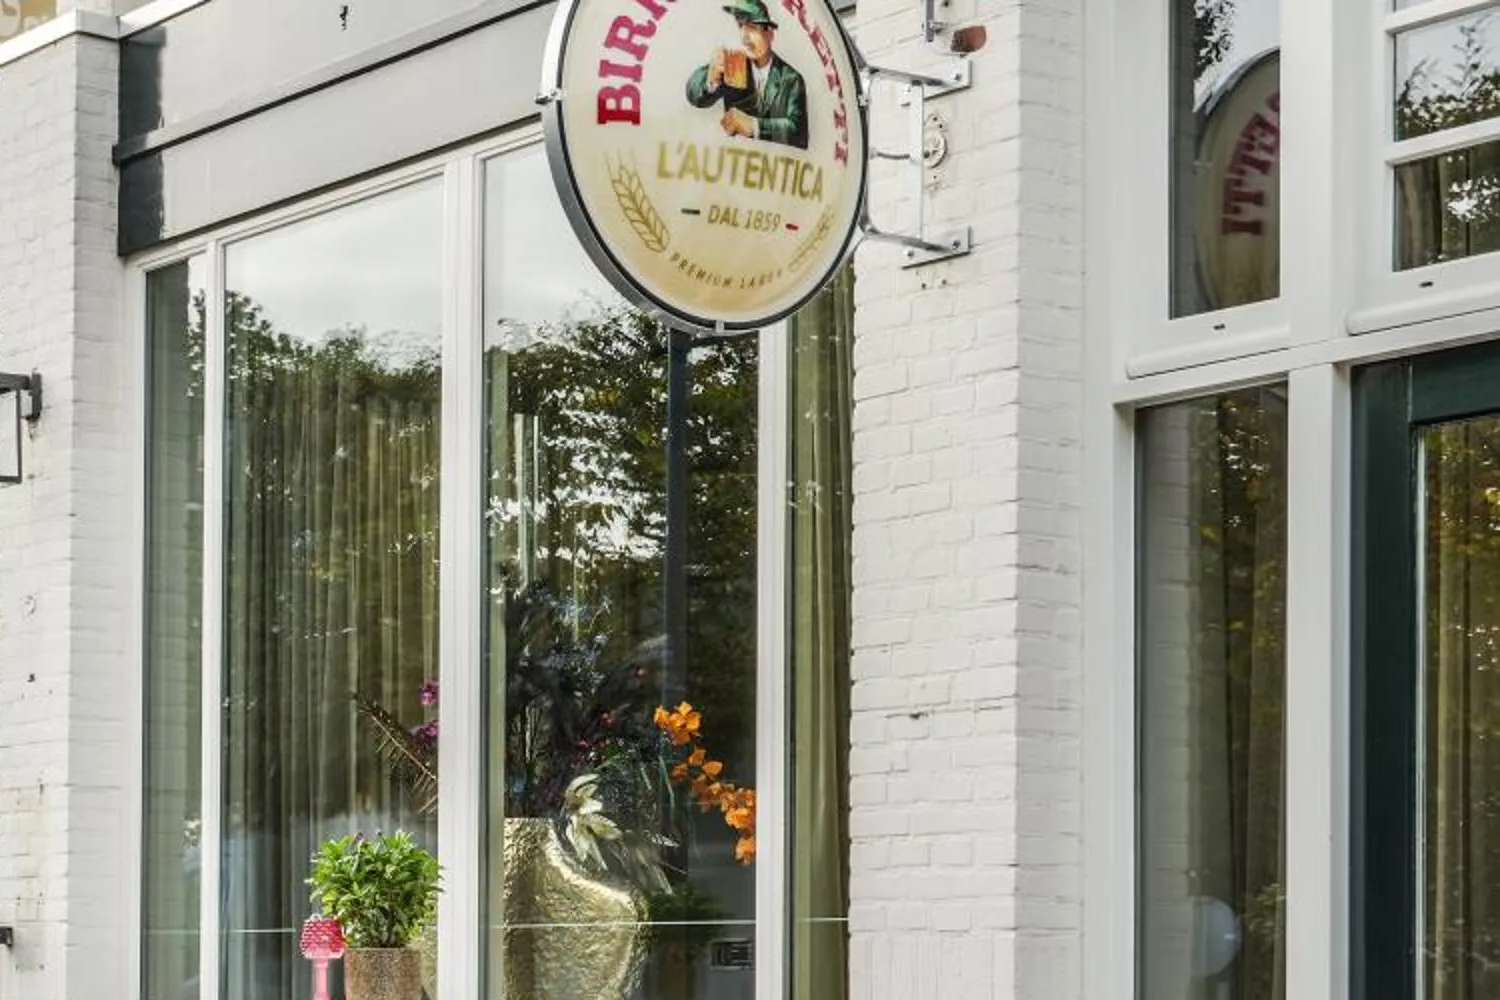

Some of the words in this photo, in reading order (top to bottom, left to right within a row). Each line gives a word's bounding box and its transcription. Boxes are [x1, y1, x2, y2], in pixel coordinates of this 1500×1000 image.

[657, 140, 823, 201] L'AUTENTICA
[707, 204, 739, 227] DAL
[744, 209, 781, 232] 1859
